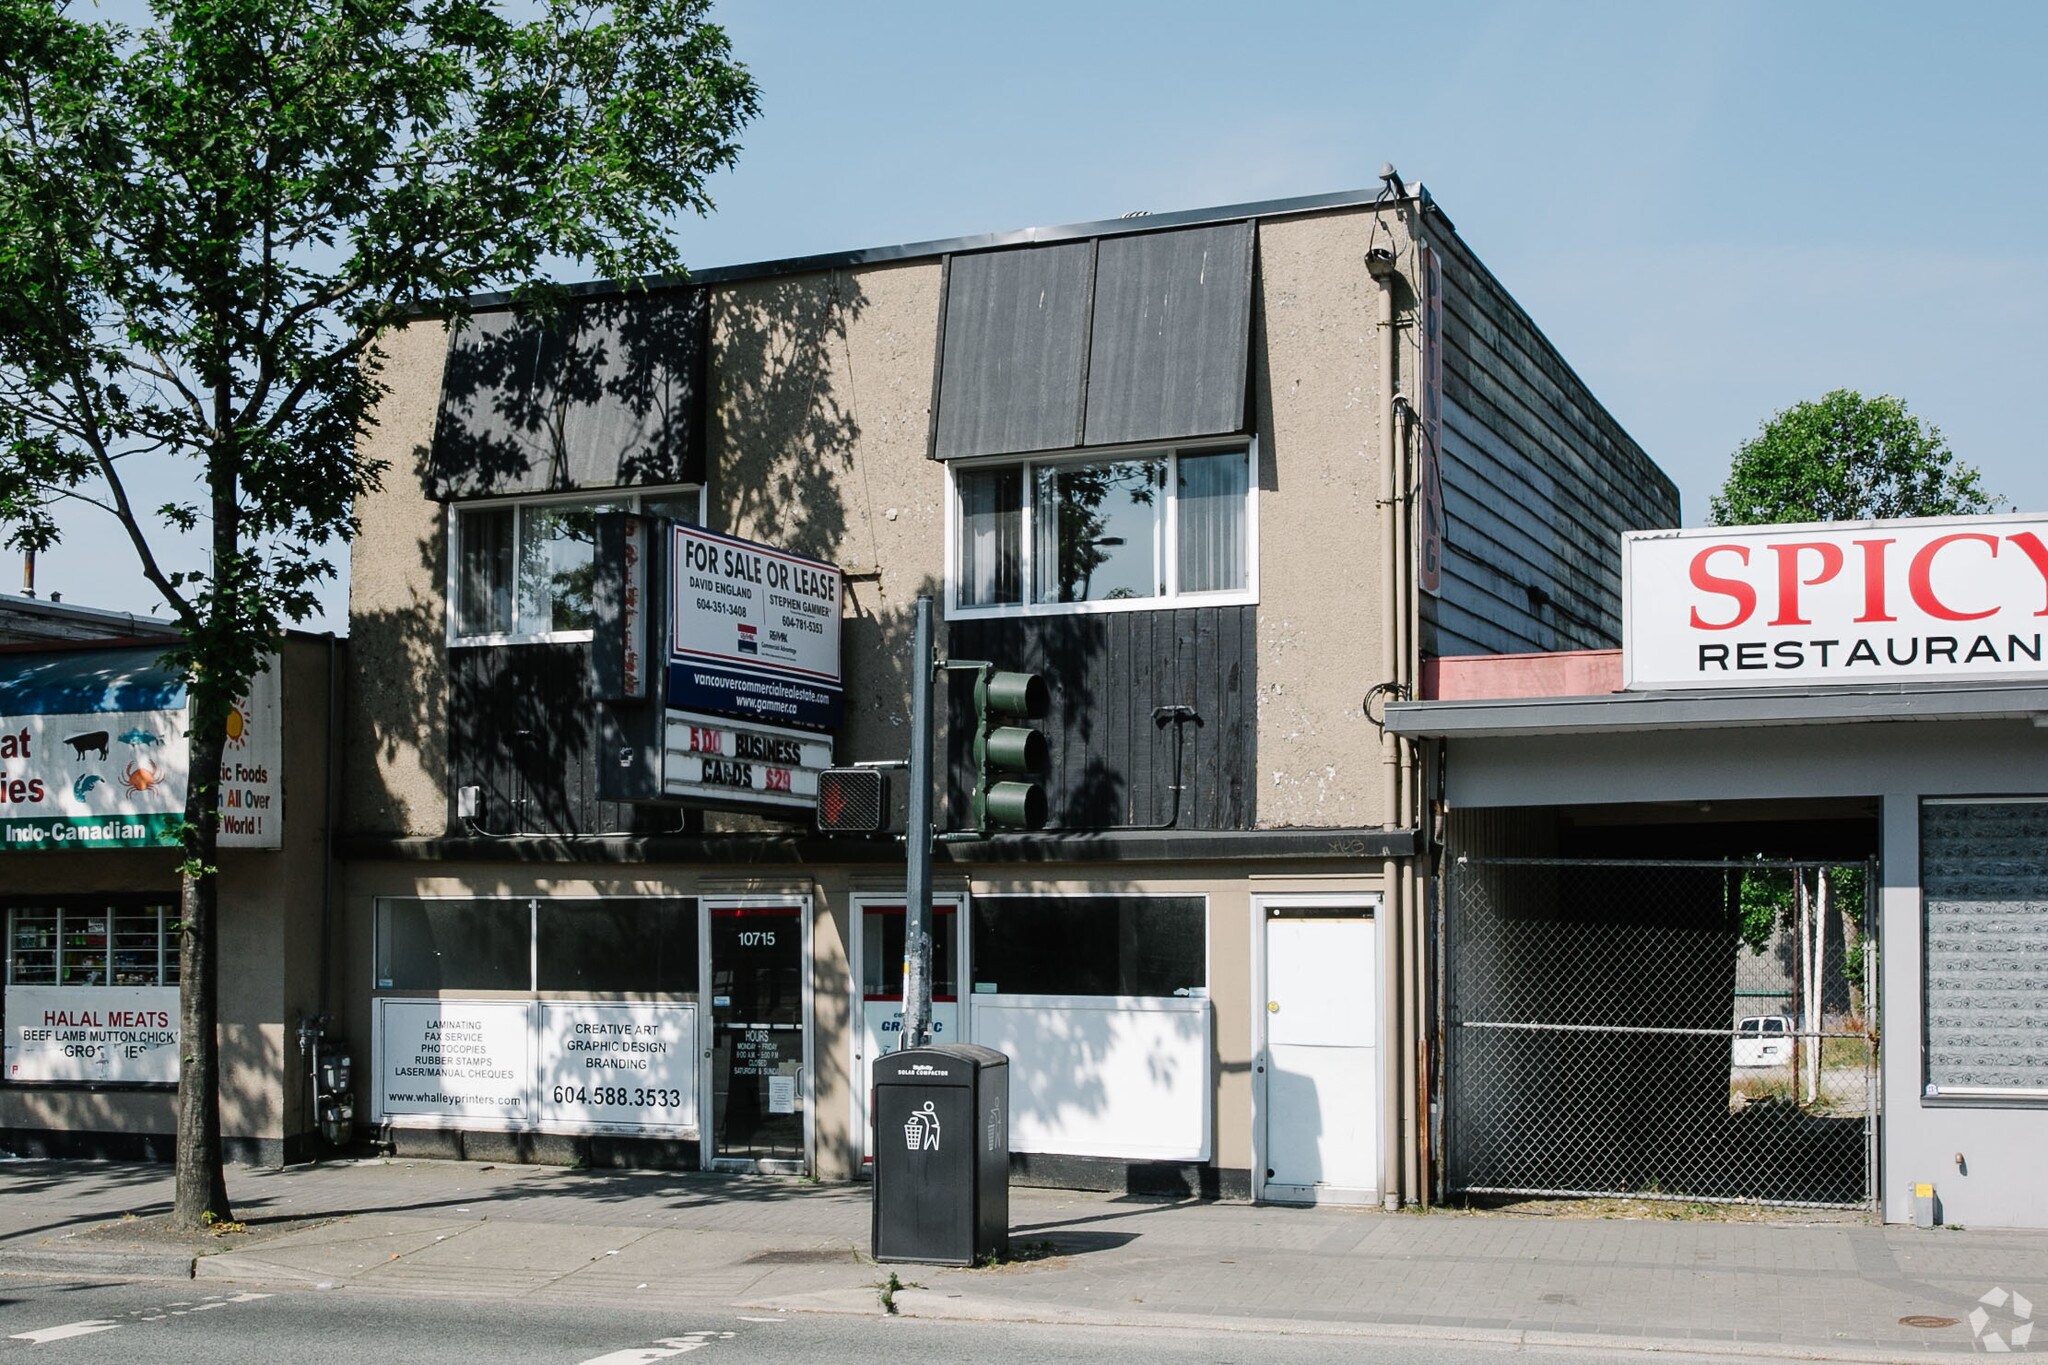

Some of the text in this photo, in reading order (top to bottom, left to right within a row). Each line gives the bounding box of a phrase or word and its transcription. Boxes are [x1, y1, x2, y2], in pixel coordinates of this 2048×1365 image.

[686, 540, 834, 601] FOR SALE OR LEASE
[690, 576, 752, 599] DAVID ENGLAND
[696, 598, 746, 618] 604-351-3408
[769, 594, 800, 611] STEPHEN
[782, 615, 823, 635] 604-781-5353
[694, 672, 830, 704] vancouvercommercialrealestate.com
[736, 695, 798, 714] www.gammer.ca
[736, 733, 800, 765] BUSINESS
[236, 763, 267, 783] Foods
[702, 760, 791, 790] CARDS $29
[228, 789, 241, 808] All
[245, 790, 270, 809] Over
[6, 821, 146, 842] Indo-Canadian
[224, 815, 254, 834] World
[738, 932, 776, 946] 10715
[44, 1010, 169, 1028] HALAL MEATS
[426, 1020, 482, 1030] LAMINATING
[23, 1030, 52, 1041] BEEF
[55, 1031, 86, 1042] LAMB
[89, 1031, 136, 1042] MUTTON
[424, 1032, 483, 1042] FAX SERVICE
[576, 1024, 658, 1036] CREATIVE ART
[745, 1030, 768, 1042] HOURS
[421, 1044, 486, 1054] PHOTOCOPIES
[568, 1040, 666, 1053] GRAPHIC DESIGN
[737, 1042, 756, 1050] MONDAY
[415, 1056, 492, 1066] RUBBER STAMPS
[586, 1058, 647, 1070] BRANDING
[395, 1068, 514, 1079] LASER/MANUAL CHEQUES
[389, 1092, 520, 1106] www.whalleyprinters.com
[554, 1086, 680, 1108] 604.588.3533
